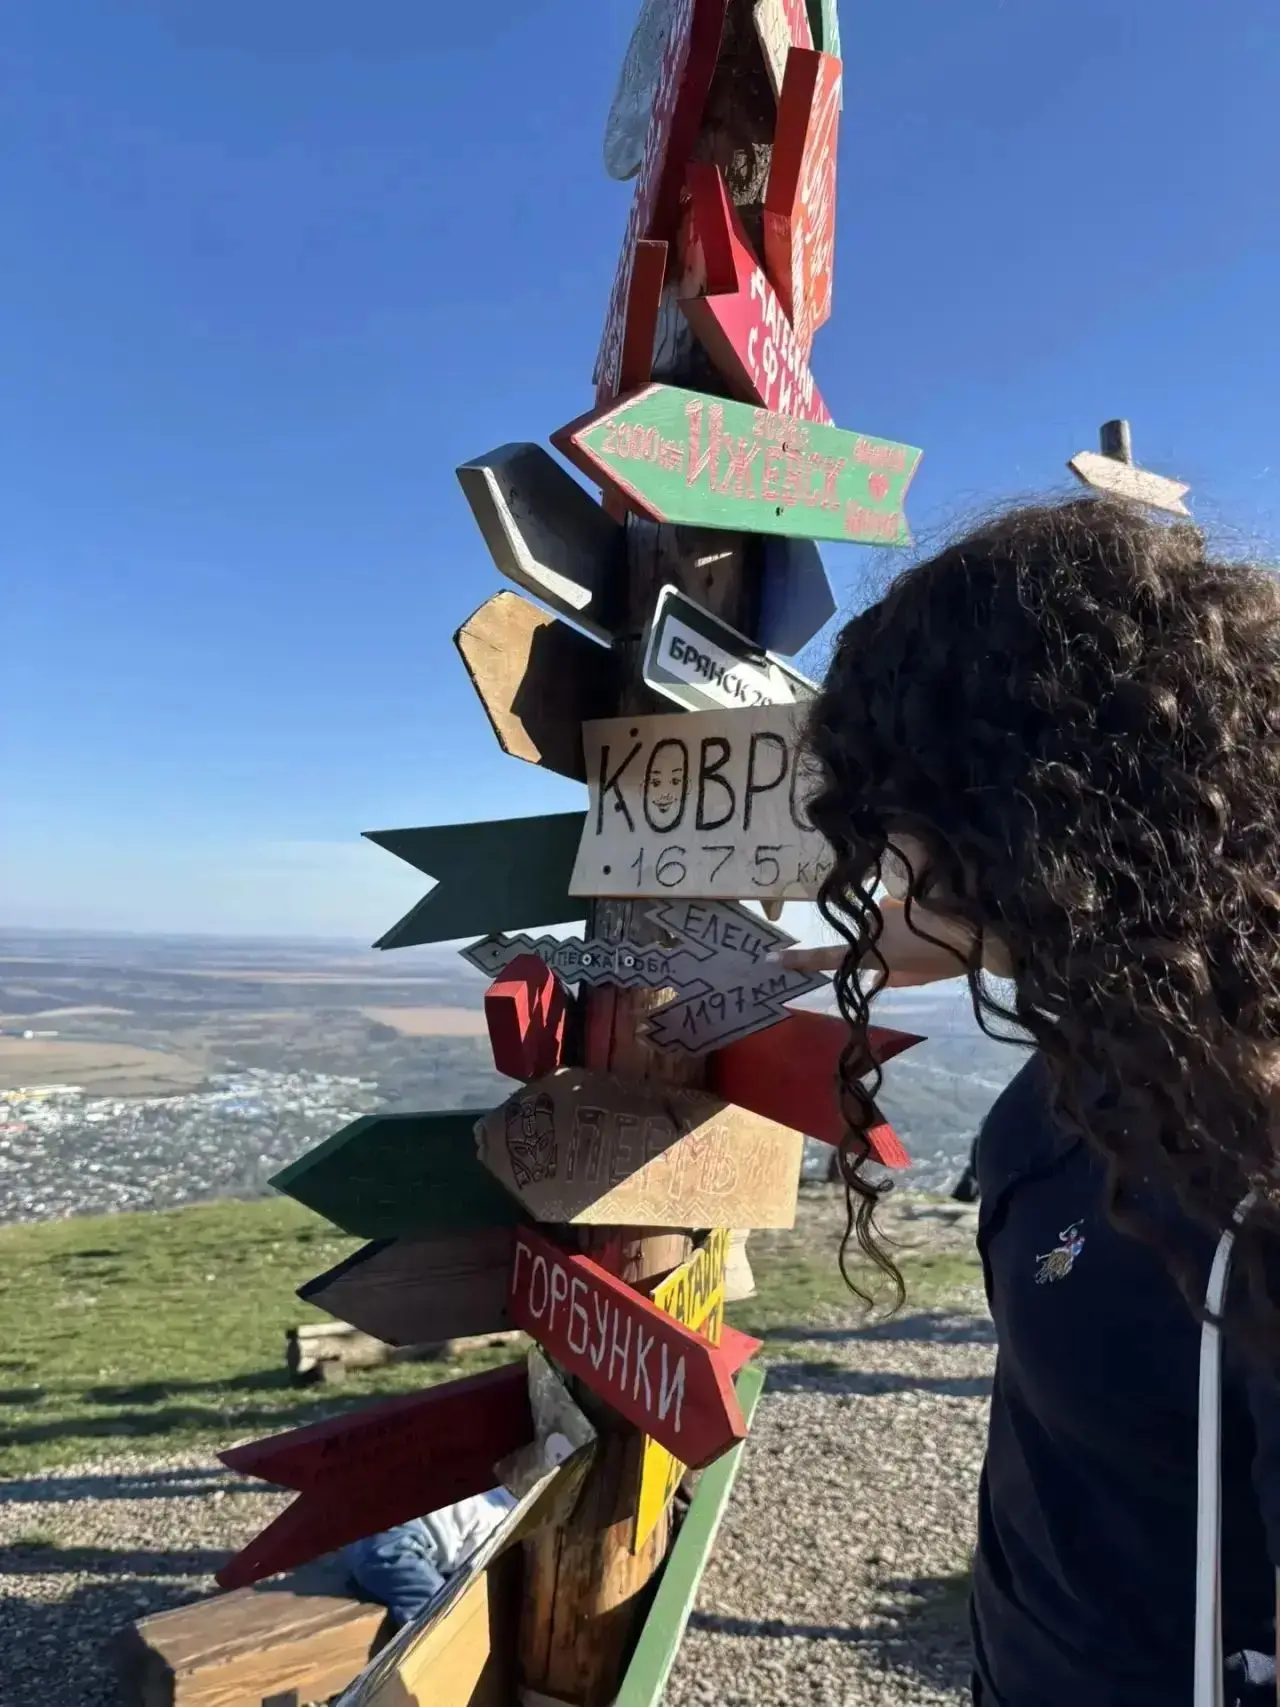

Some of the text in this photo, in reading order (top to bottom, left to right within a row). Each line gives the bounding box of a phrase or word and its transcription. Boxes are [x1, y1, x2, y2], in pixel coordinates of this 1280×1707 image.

[684, 399, 847, 509] ИЖЕВСК
[669, 636, 749, 703] БРЯНСК
[631, 845, 785, 888] 1675
[683, 904, 762, 964] ЕЛЕЦ
[682, 985, 745, 1035] 1197
[563, 1105, 739, 1201] ПЕРМЬ
[513, 1241, 686, 1434] ГОРБУНКИ
